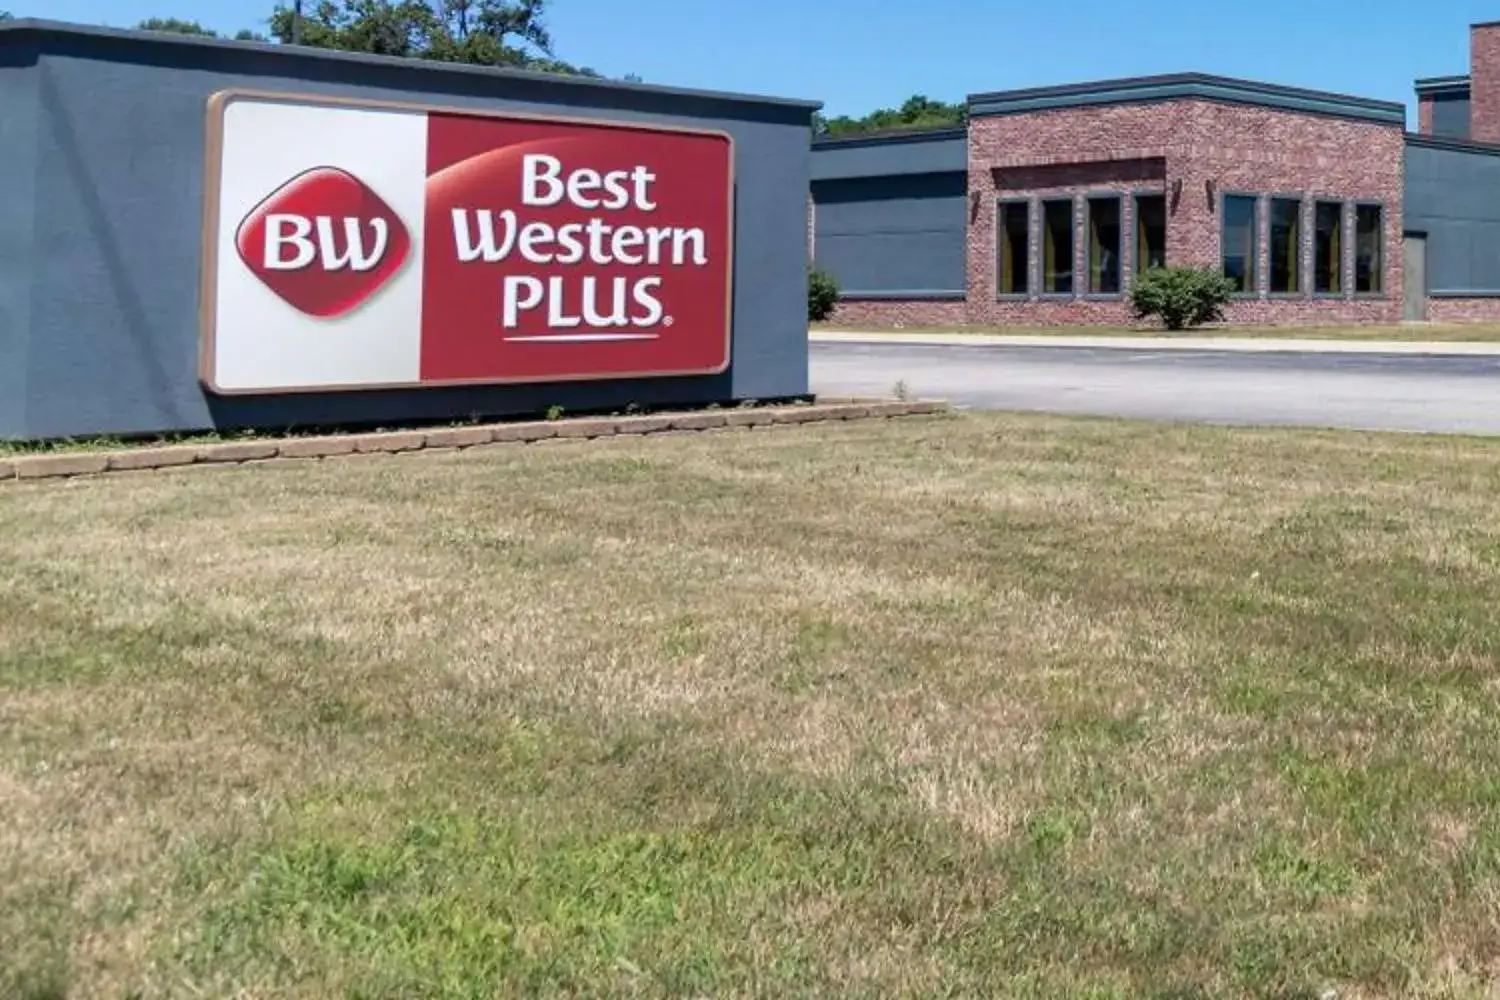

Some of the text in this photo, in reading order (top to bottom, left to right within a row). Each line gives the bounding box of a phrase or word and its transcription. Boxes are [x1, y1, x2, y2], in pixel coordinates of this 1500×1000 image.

[522, 153, 657, 211] Best
[263, 213, 388, 271] BW
[451, 208, 708, 265] Western
